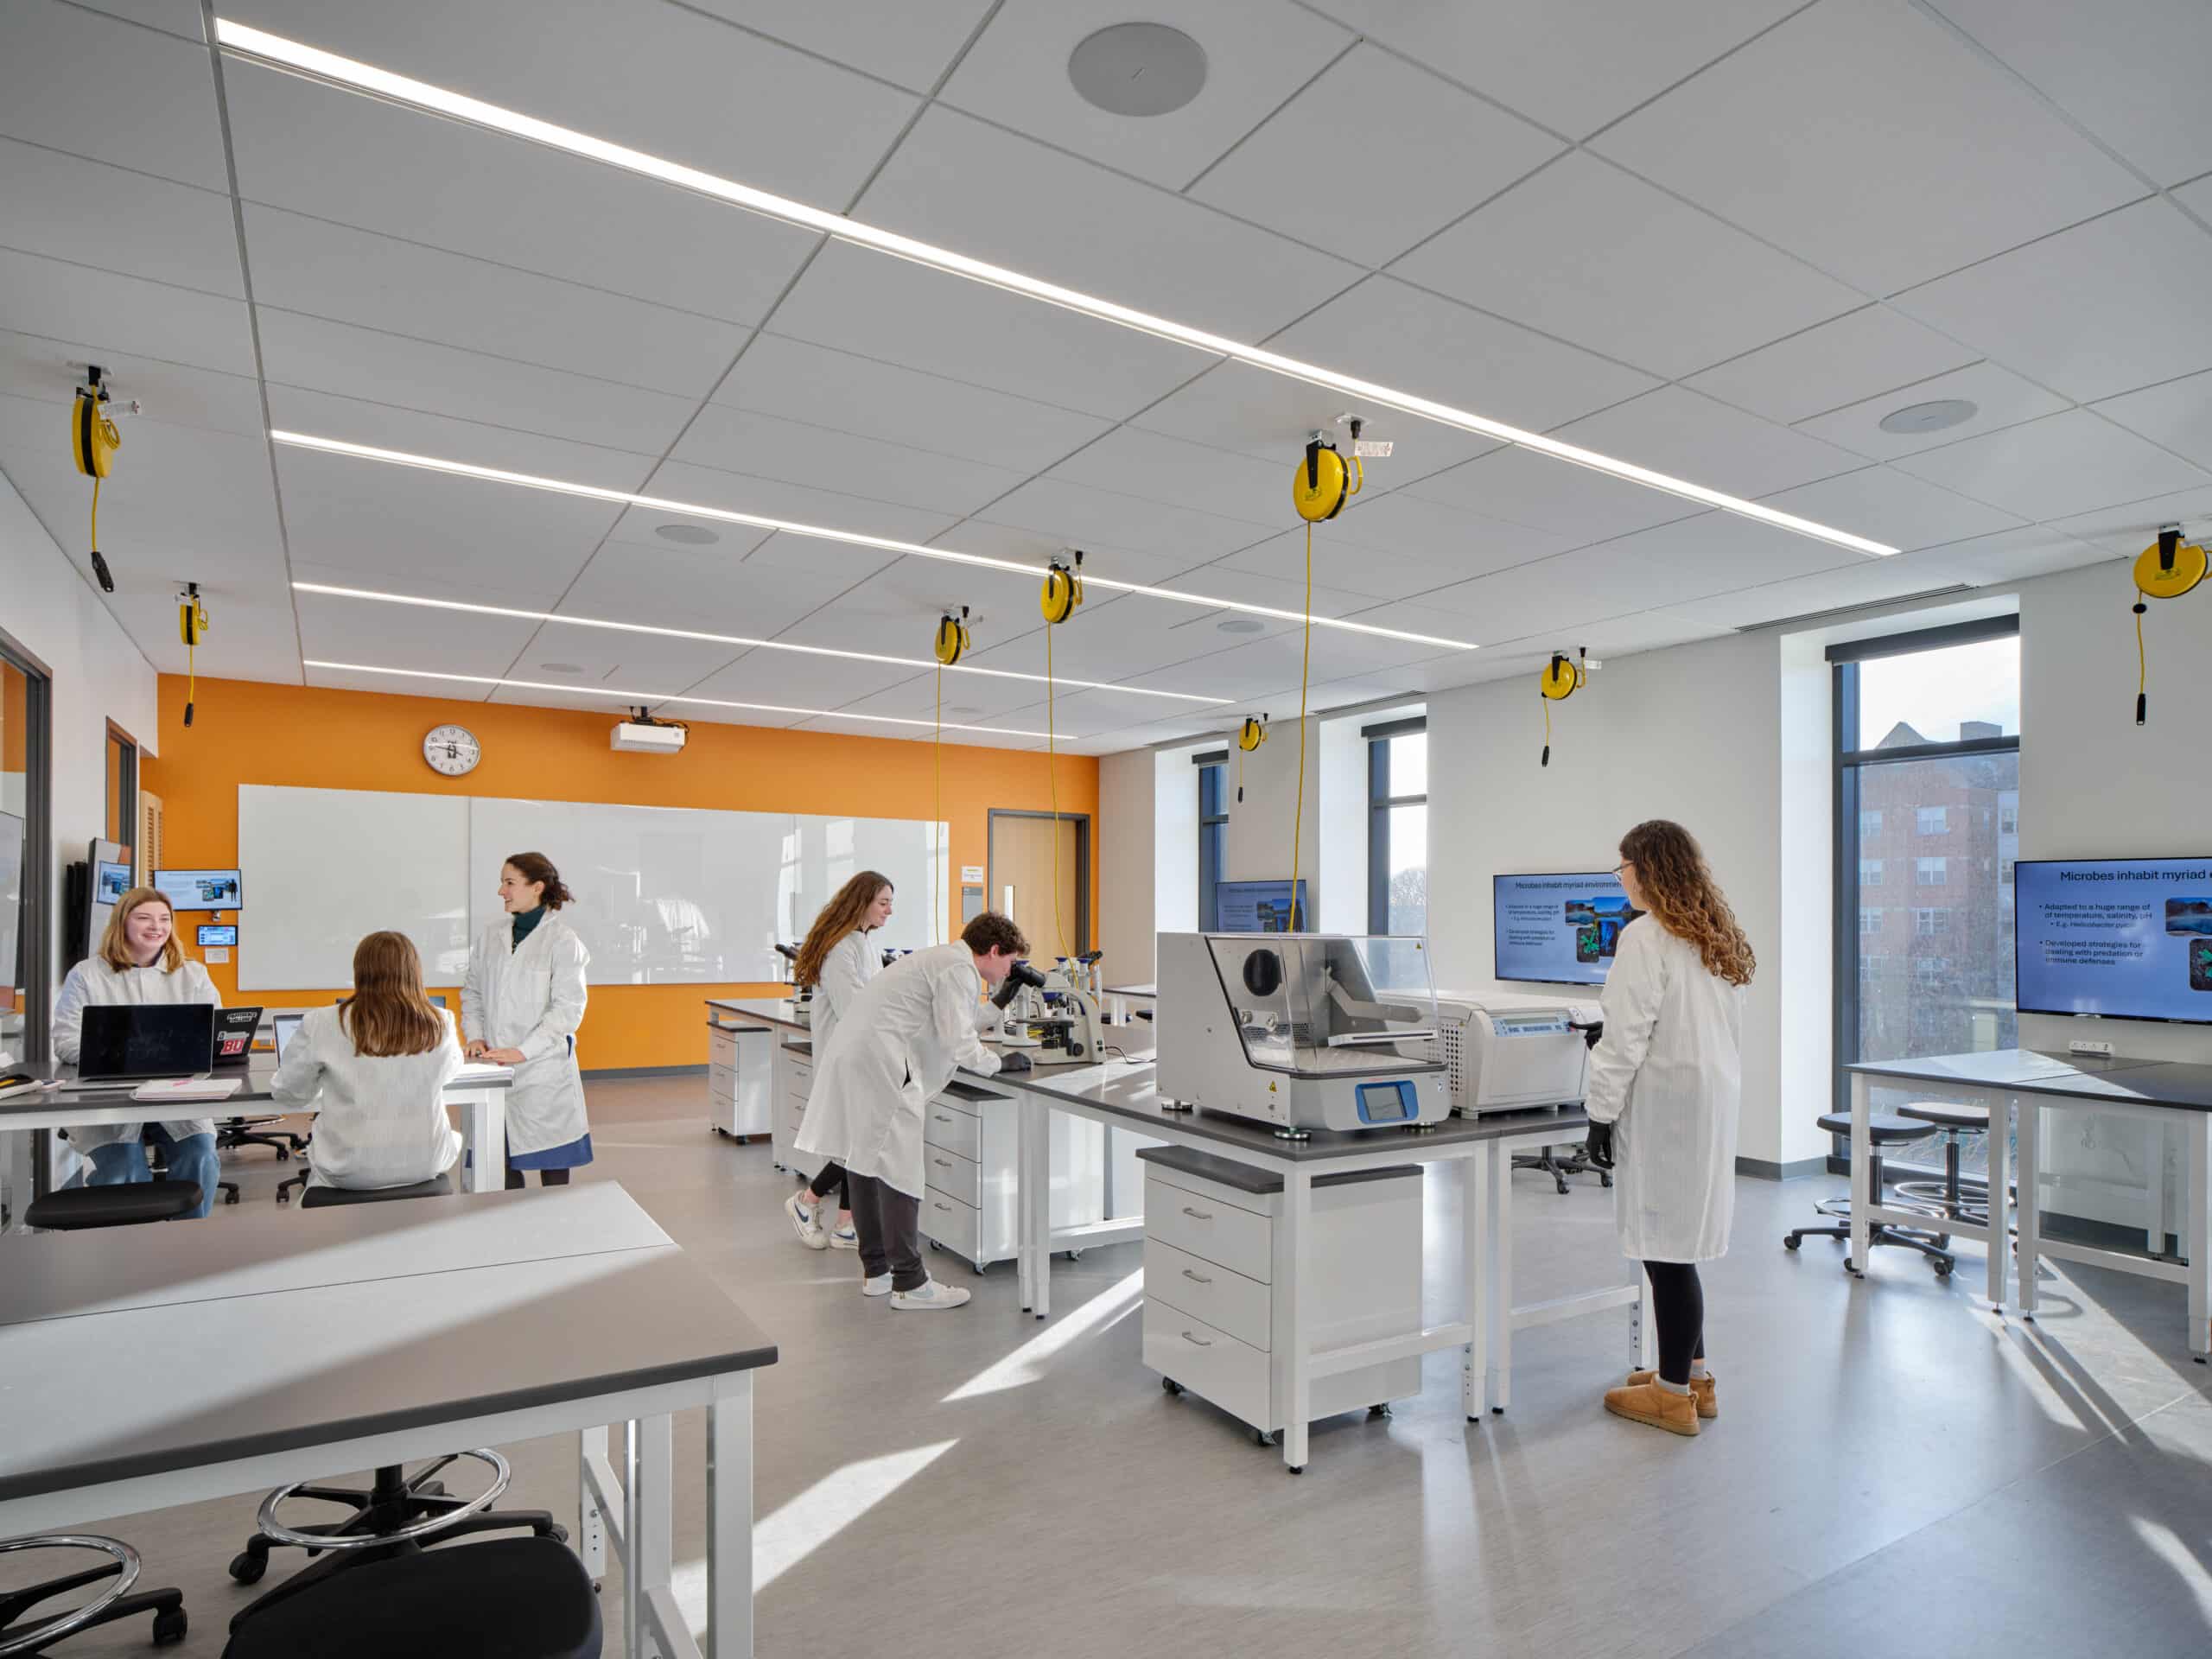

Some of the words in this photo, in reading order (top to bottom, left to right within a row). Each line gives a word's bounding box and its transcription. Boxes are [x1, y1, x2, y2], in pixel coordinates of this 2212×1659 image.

[2060, 871, 2114, 881] Microbes
[2117, 870, 2159, 880] inhabit
[2161, 869, 2206, 881] myriad
[222, 1038, 245, 1053] BU
